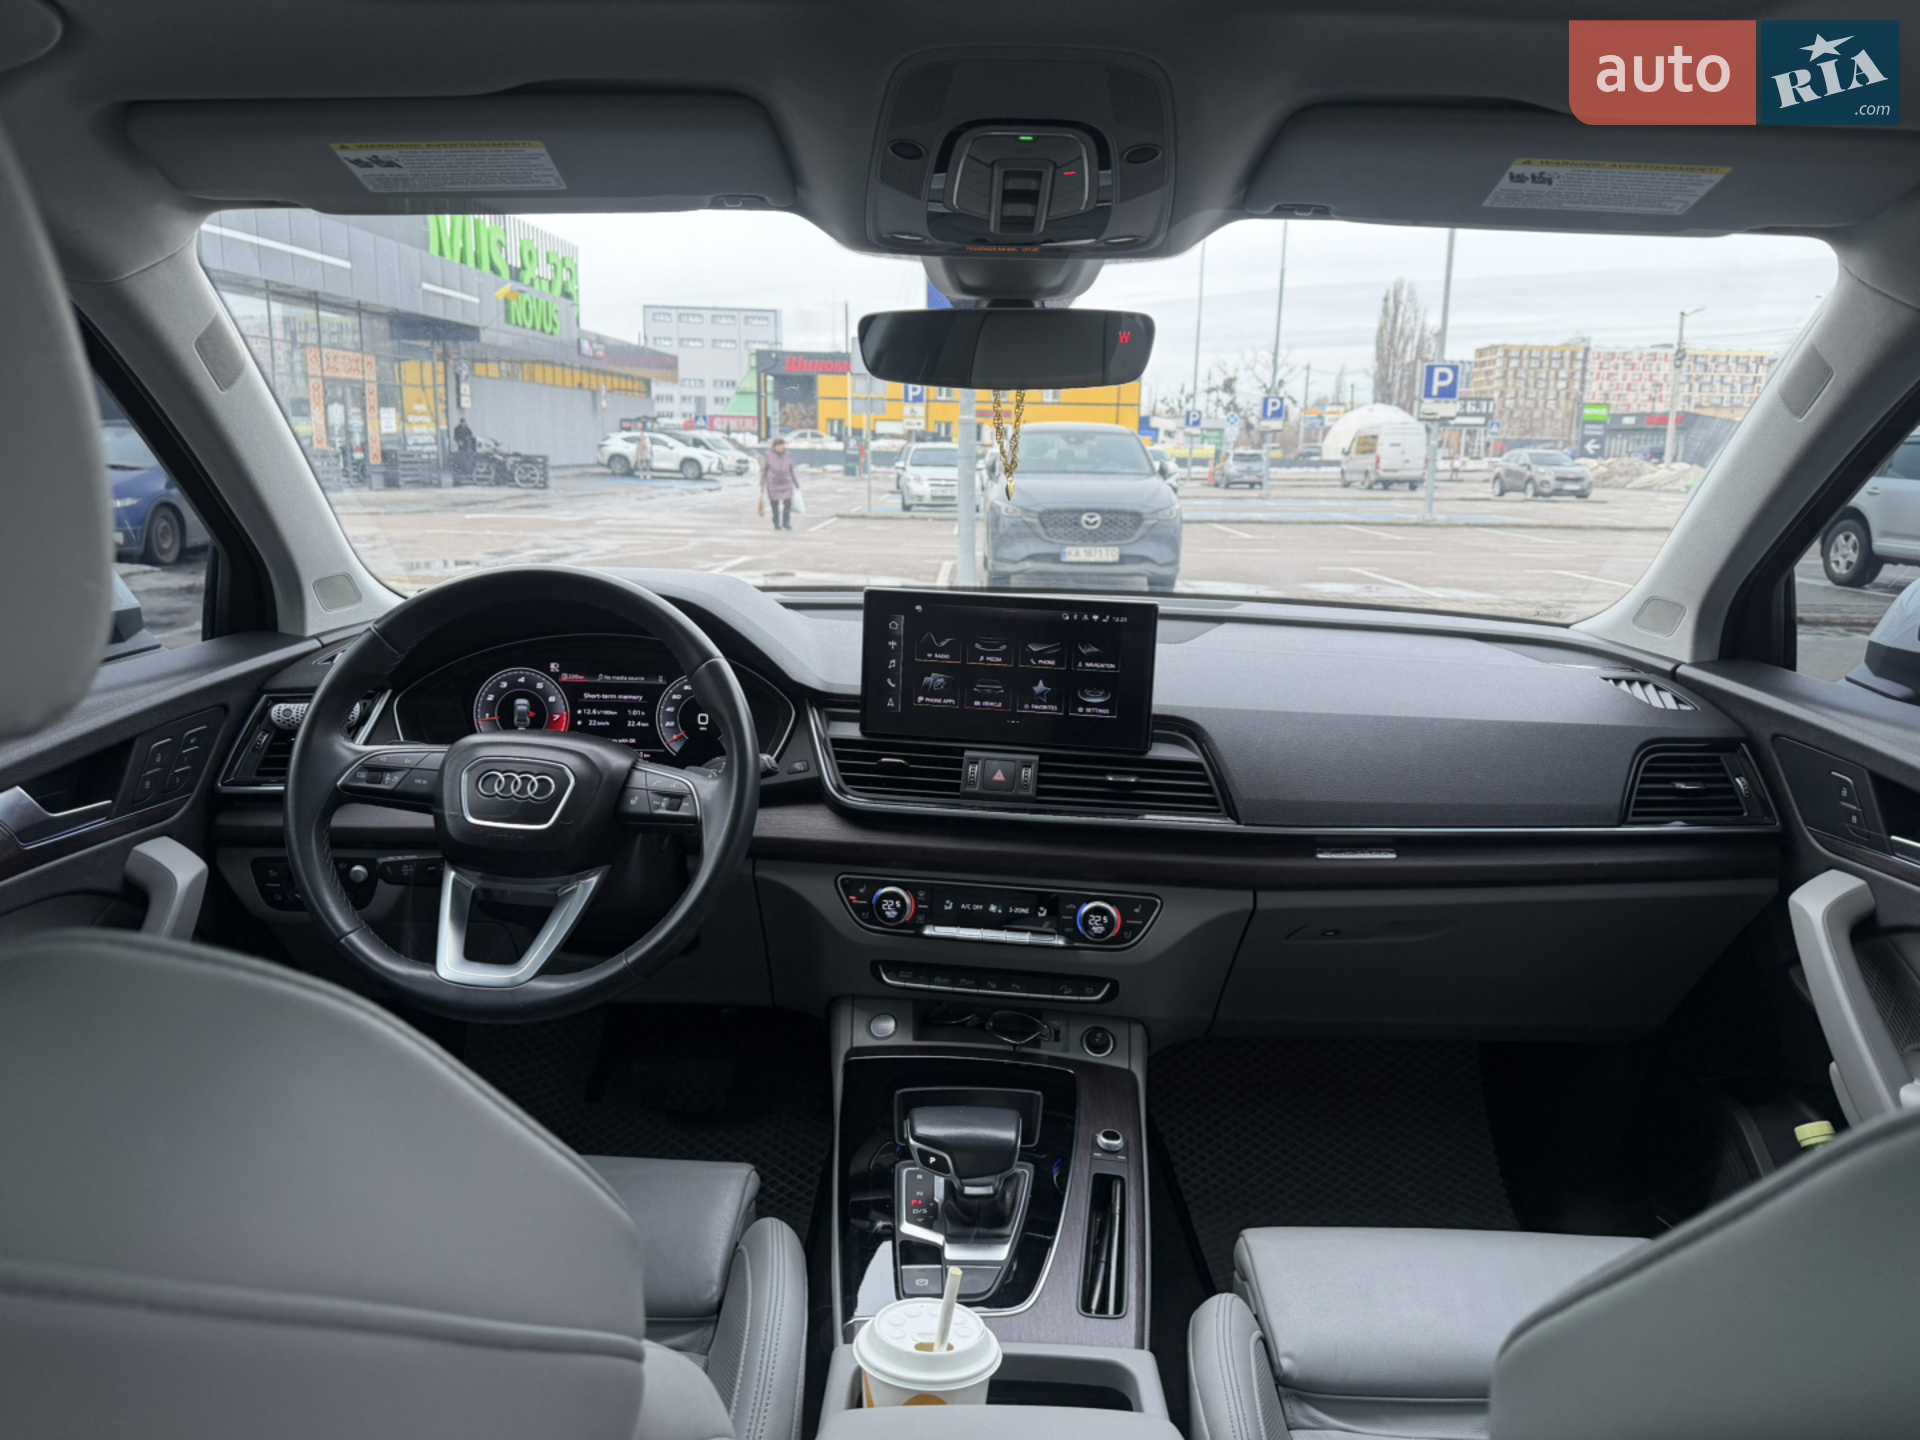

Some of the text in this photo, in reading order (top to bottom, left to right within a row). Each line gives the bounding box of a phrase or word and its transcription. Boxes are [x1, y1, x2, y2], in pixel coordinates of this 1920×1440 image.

[1539, 160, 1720, 173] WARNING! AVERTISSEMENT!
[507, 293, 561, 337] NOVUS
[1119, 332, 1130, 344] W
[1432, 367, 1454, 397] P
[1267, 399, 1280, 417] P
[1455, 400, 1495, 414] ЕБЛІ
[1189, 411, 1200, 426] P
[518, 675, 526, 684] 4
[499, 680, 508, 689] 3
[535, 681, 544, 690] 5
[486, 694, 495, 702] 2
[583, 692, 643, 702] Short-term memory
[925, 696, 942, 704] PHONE
[982, 700, 1003, 708] VEHICLE
[1031, 704, 1058, 712] FAVORITES
[1085, 707, 1110, 715] SETTINGS
[552, 713, 561, 722] 7
[697, 713, 709, 725] 0
[588, 719, 597, 727] 22
[627, 720, 641, 728] 22.4
[961, 903, 972, 911] A/C
[1008, 906, 1030, 914] 3-ZONE
[929, 1156, 936, 1165] P
